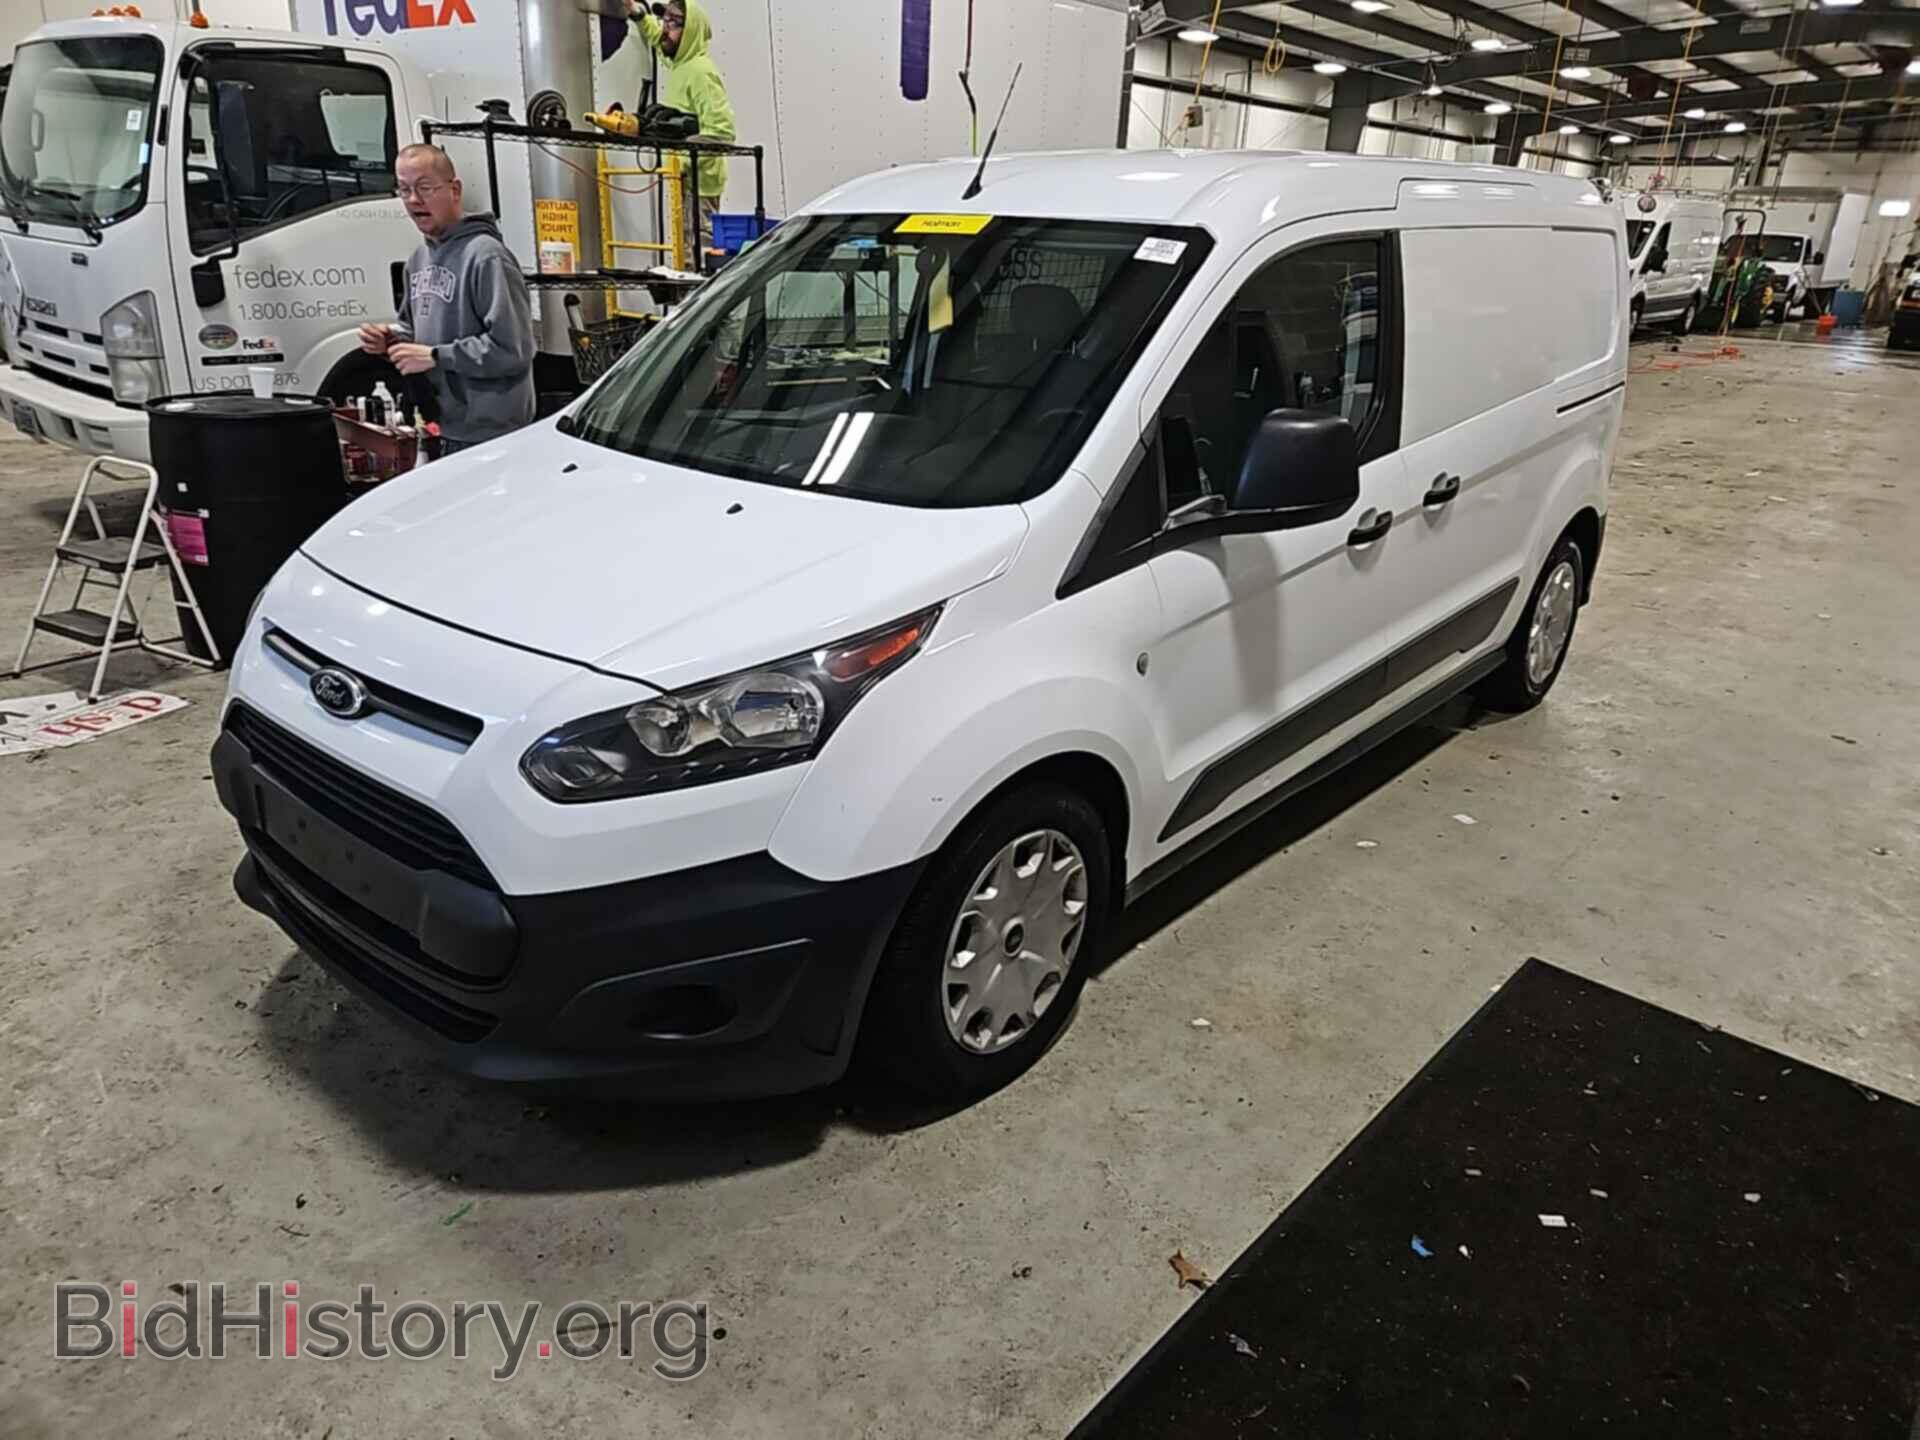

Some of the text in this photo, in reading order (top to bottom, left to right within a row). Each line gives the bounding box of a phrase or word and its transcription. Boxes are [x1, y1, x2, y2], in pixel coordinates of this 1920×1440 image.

[232, 264, 366, 289] fedex.com
[238, 299, 368, 321] 1.800.GoFedEx
[242, 338, 275, 350] FedEx
[194, 375, 217, 391] US
[315, 675, 346, 706] Ford
